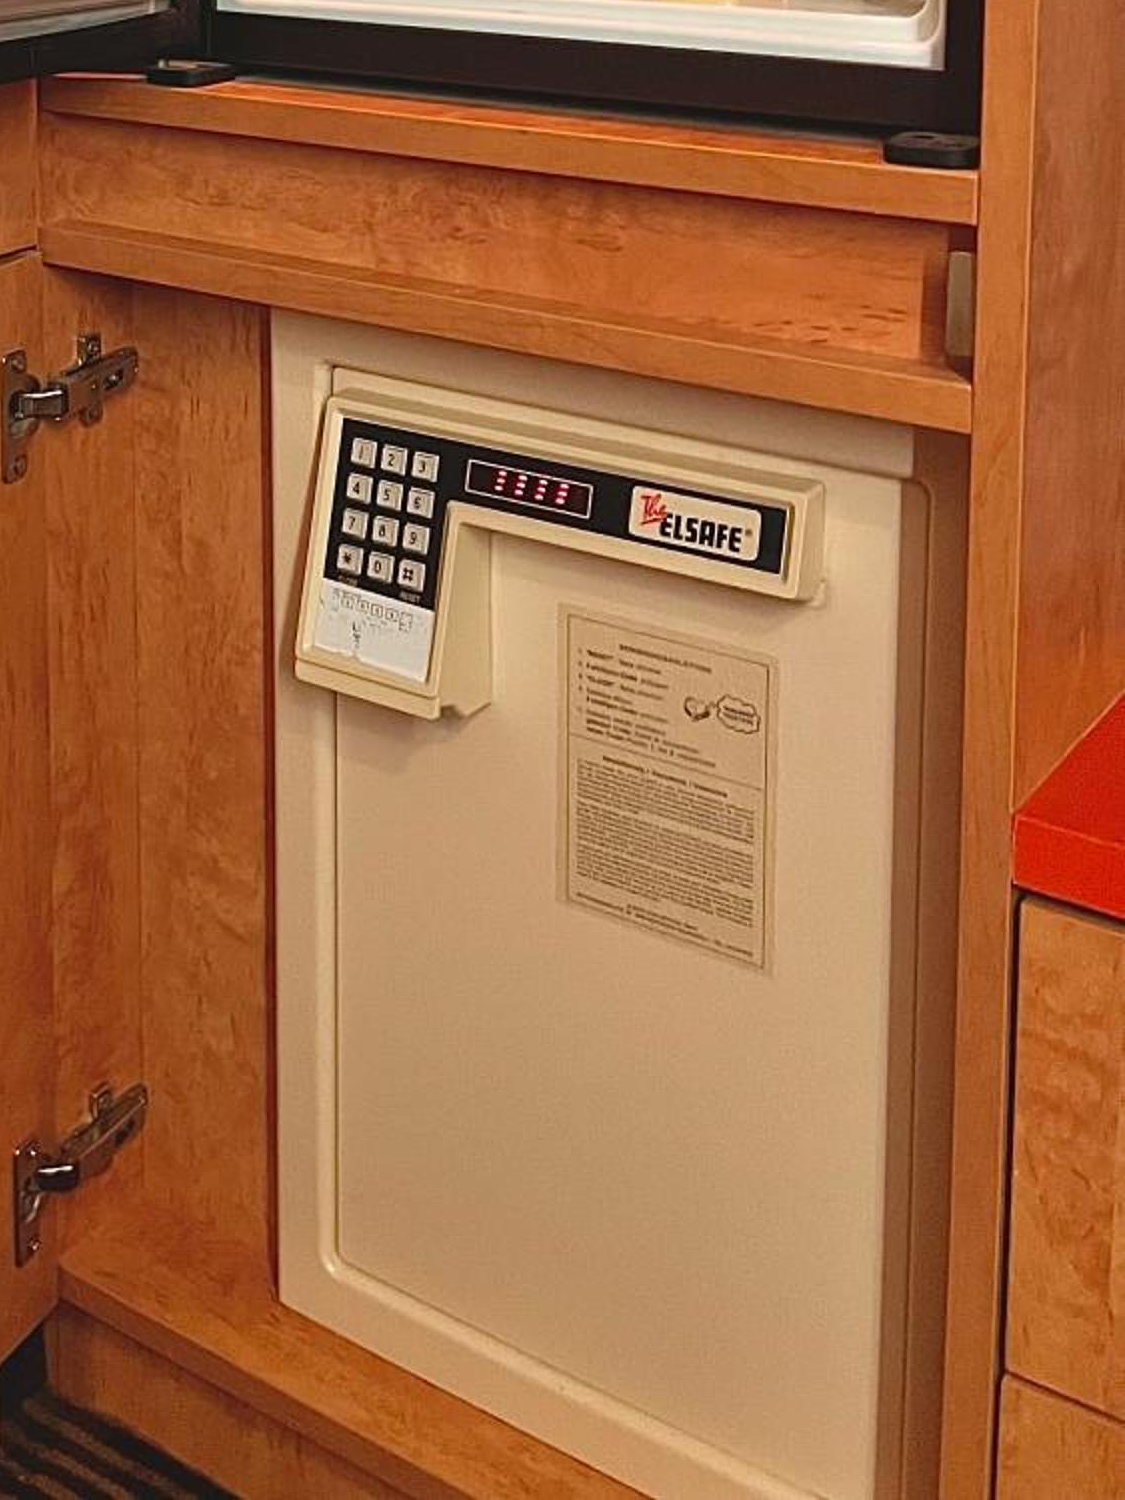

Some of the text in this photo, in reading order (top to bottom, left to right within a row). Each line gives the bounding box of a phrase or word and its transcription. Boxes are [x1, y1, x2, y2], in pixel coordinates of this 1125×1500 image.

[387, 453, 396, 467] 2
[418, 460, 426, 474] 3
[352, 481, 422, 510] 4 5 6
[641, 493, 668, 521] The
[348, 517, 418, 546] 7 8 9
[659, 512, 743, 553] ELSAFE
[374, 560, 382, 574] 0
